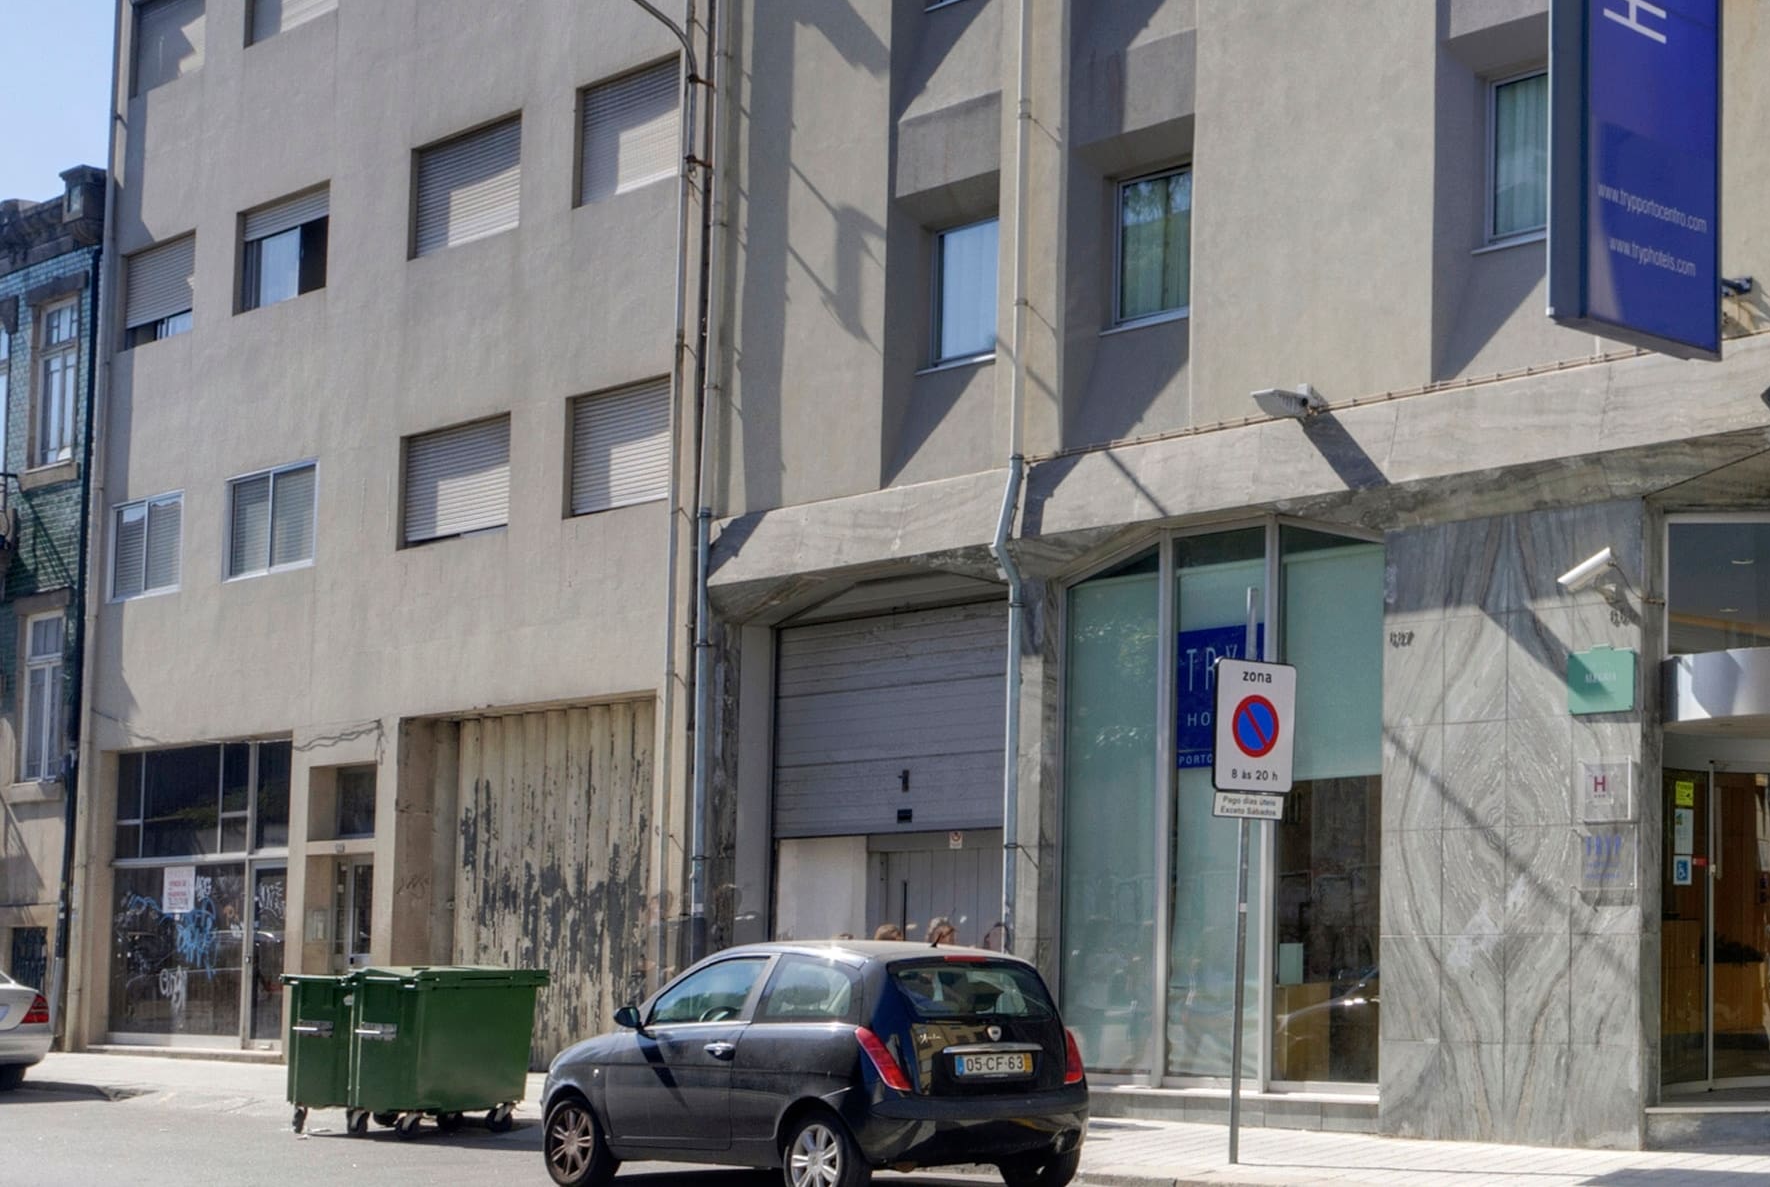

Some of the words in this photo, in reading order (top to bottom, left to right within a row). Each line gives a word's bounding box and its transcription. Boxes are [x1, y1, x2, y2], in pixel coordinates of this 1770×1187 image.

[1597, 183, 1708, 234] www.trypportocentro.com
[1608, 236, 1697, 278] www.tryphotels.com
[1242, 670, 1273, 684] zona
[1231, 767, 1238, 779] 8
[1255, 769, 1269, 781] 20
[1271, 770, 1278, 781] h
[1593, 775, 1606, 793] H
[966, 1056, 1025, 1072] 05-CF-63
